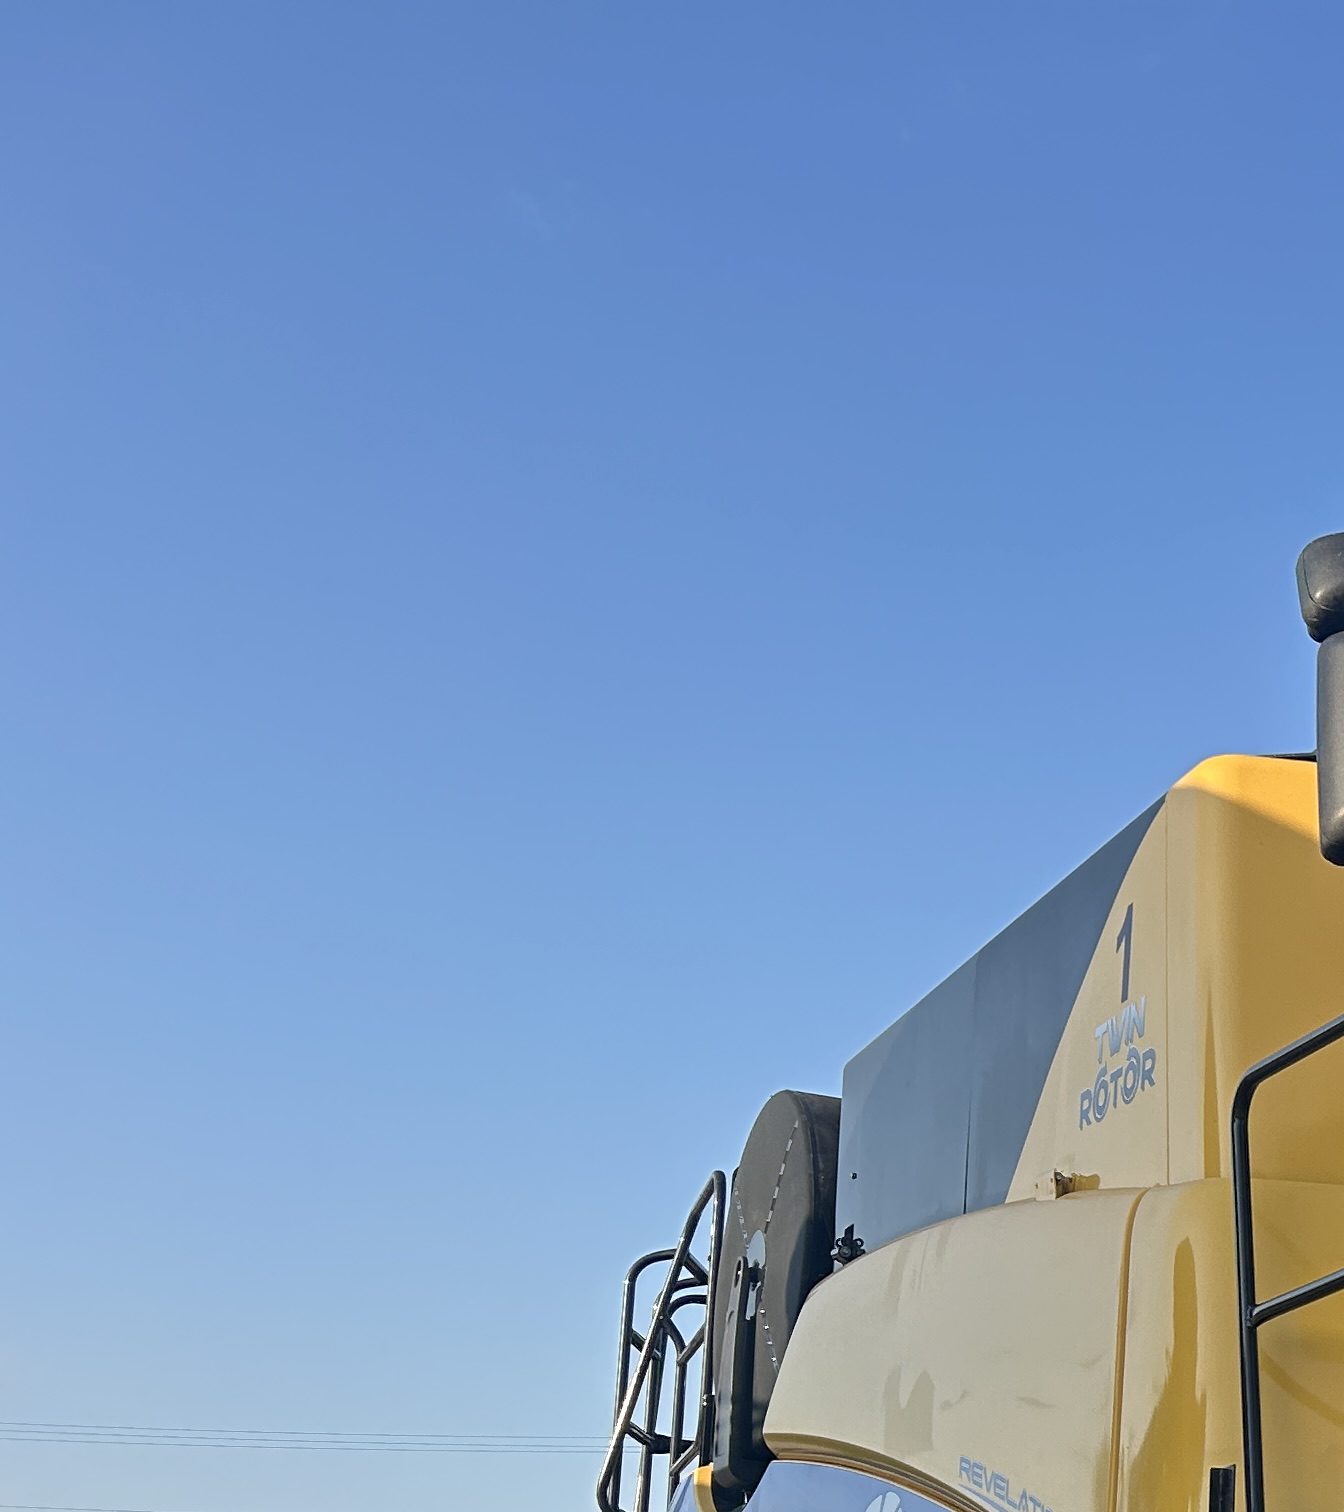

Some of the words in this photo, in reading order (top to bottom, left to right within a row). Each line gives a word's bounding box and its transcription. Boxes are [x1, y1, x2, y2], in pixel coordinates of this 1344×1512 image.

[1115, 901, 1134, 1004] 1
[1094, 995, 1147, 1064] TWIN
[1078, 1045, 1156, 1131] ROTOR
